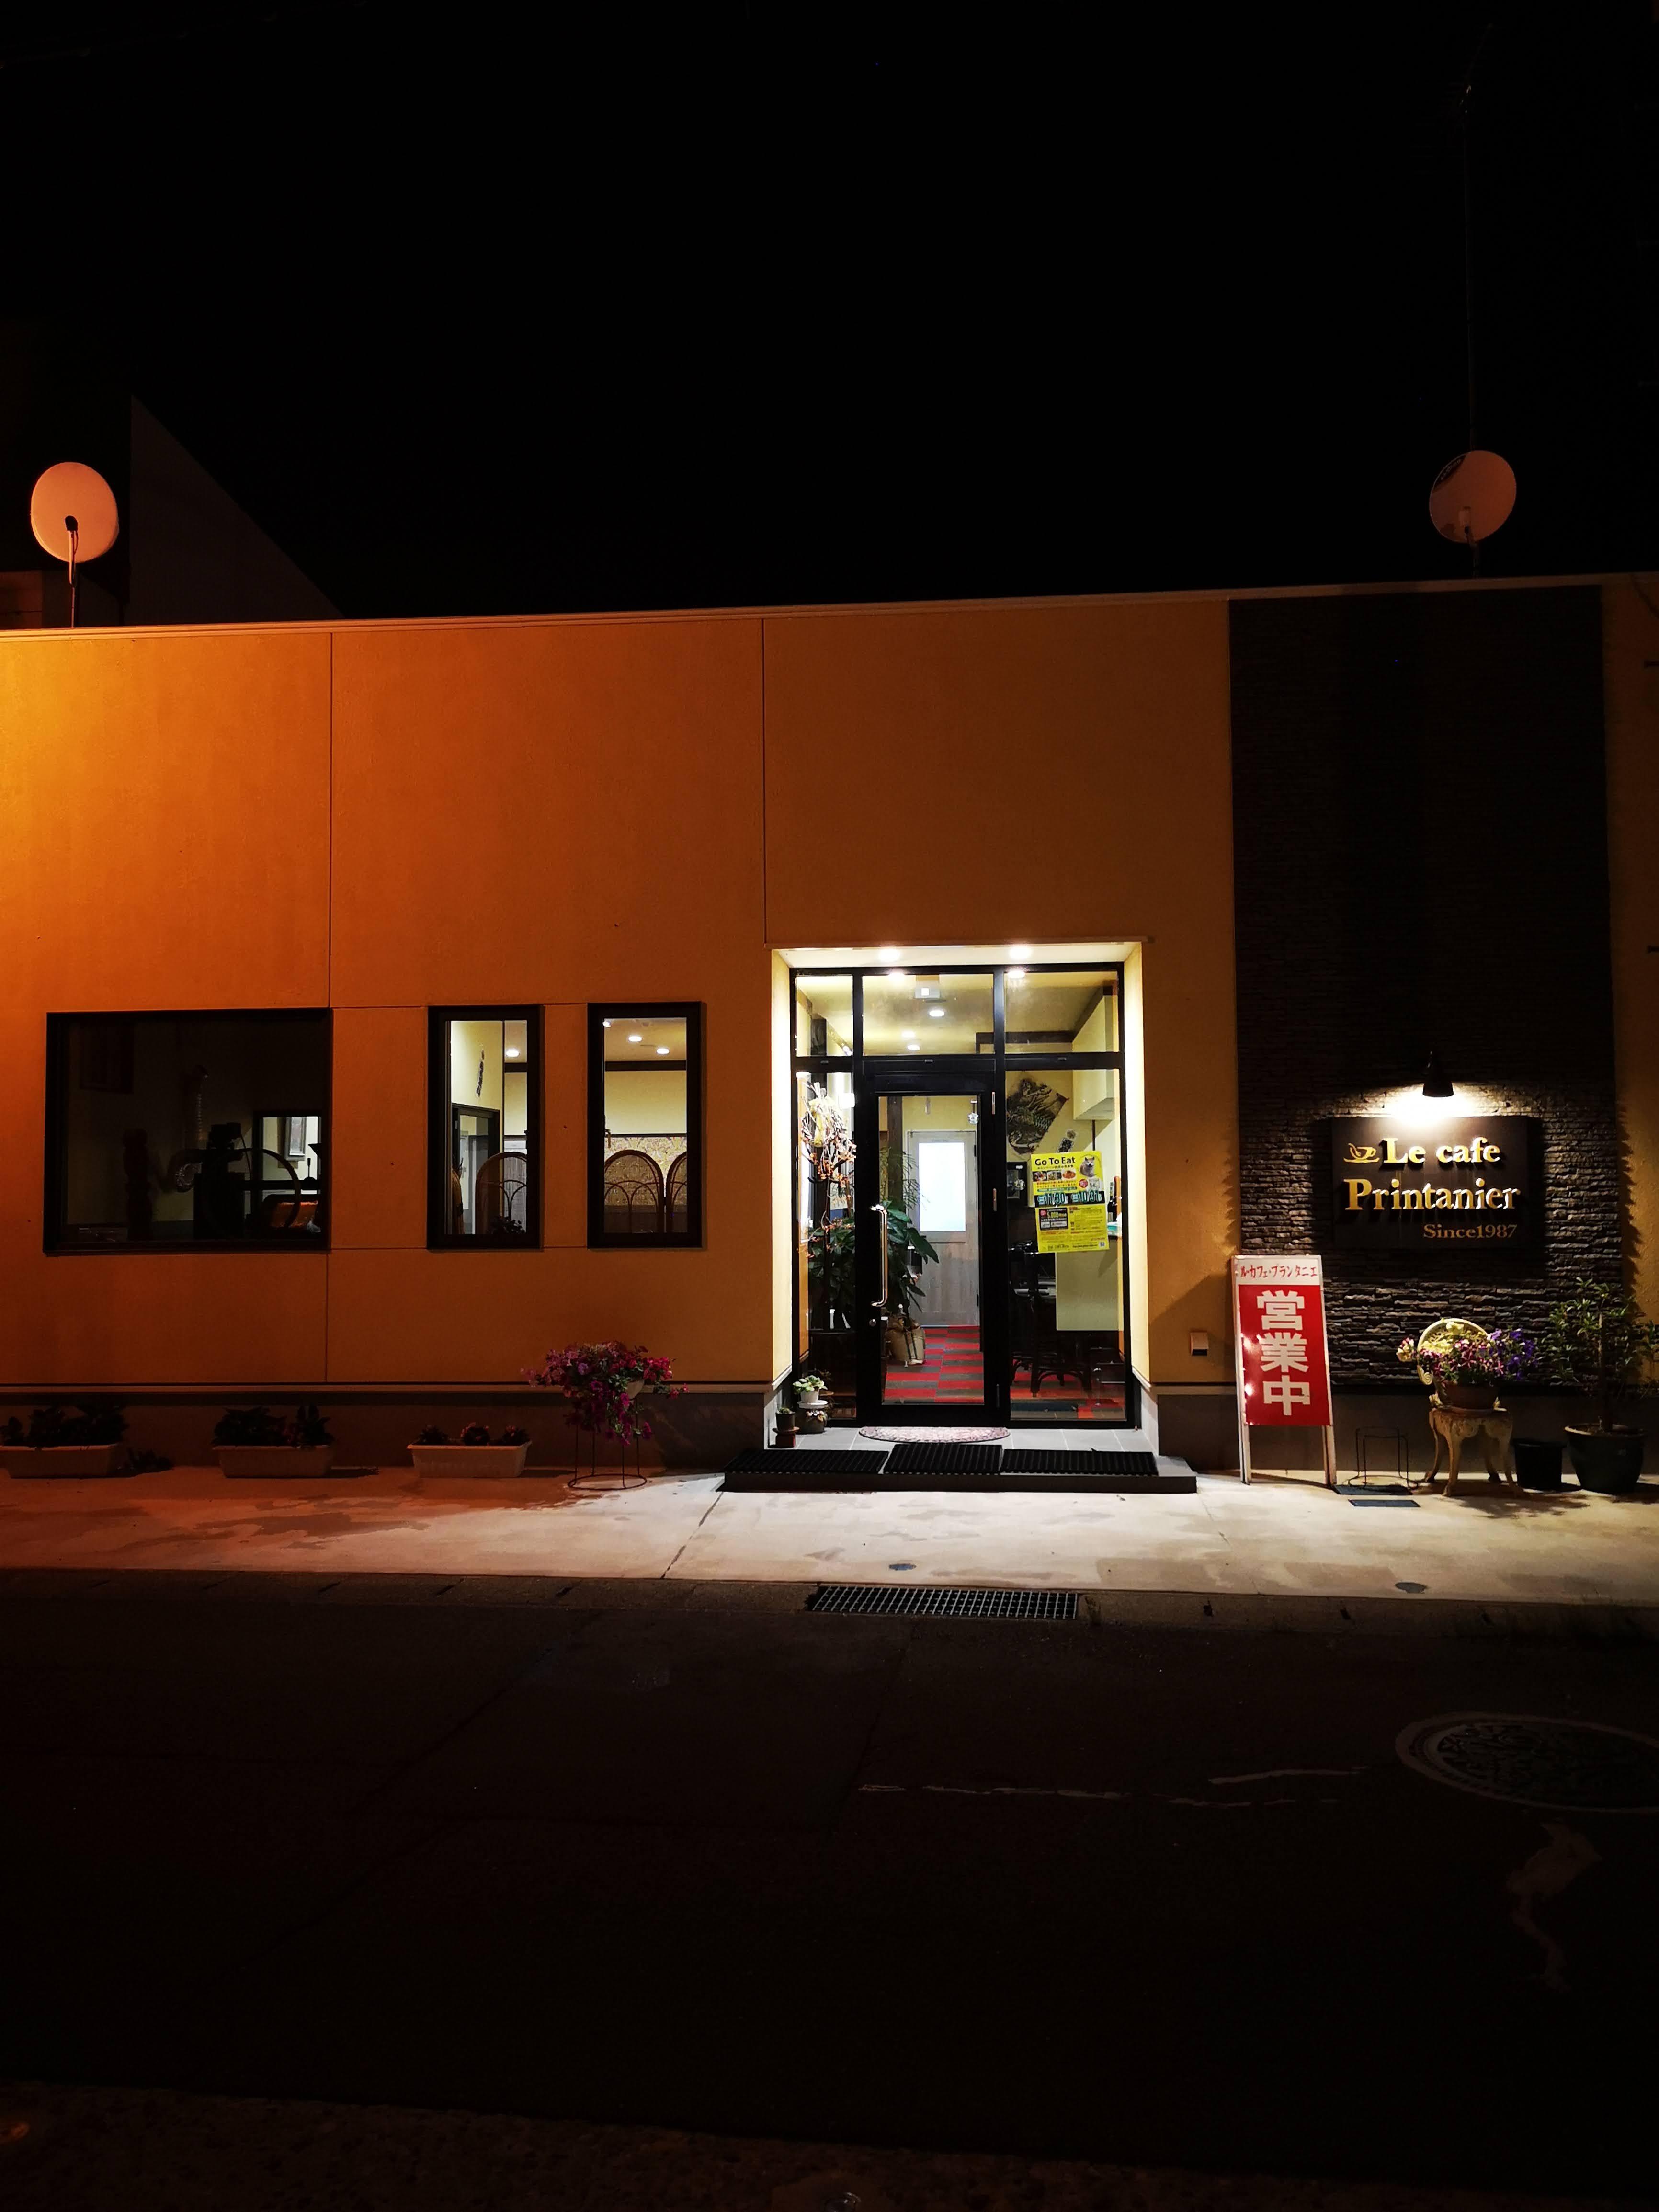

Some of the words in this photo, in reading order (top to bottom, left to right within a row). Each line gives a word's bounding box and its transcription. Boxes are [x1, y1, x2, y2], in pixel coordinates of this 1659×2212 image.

[1383, 1138, 1426, 1163] Le
[1436, 1137, 1500, 1163] cafe
[1343, 1178, 1521, 1210] Printanier
[1423, 1224, 1518, 1239] Since1987
[1256, 1289, 1311, 1415] 営業中
